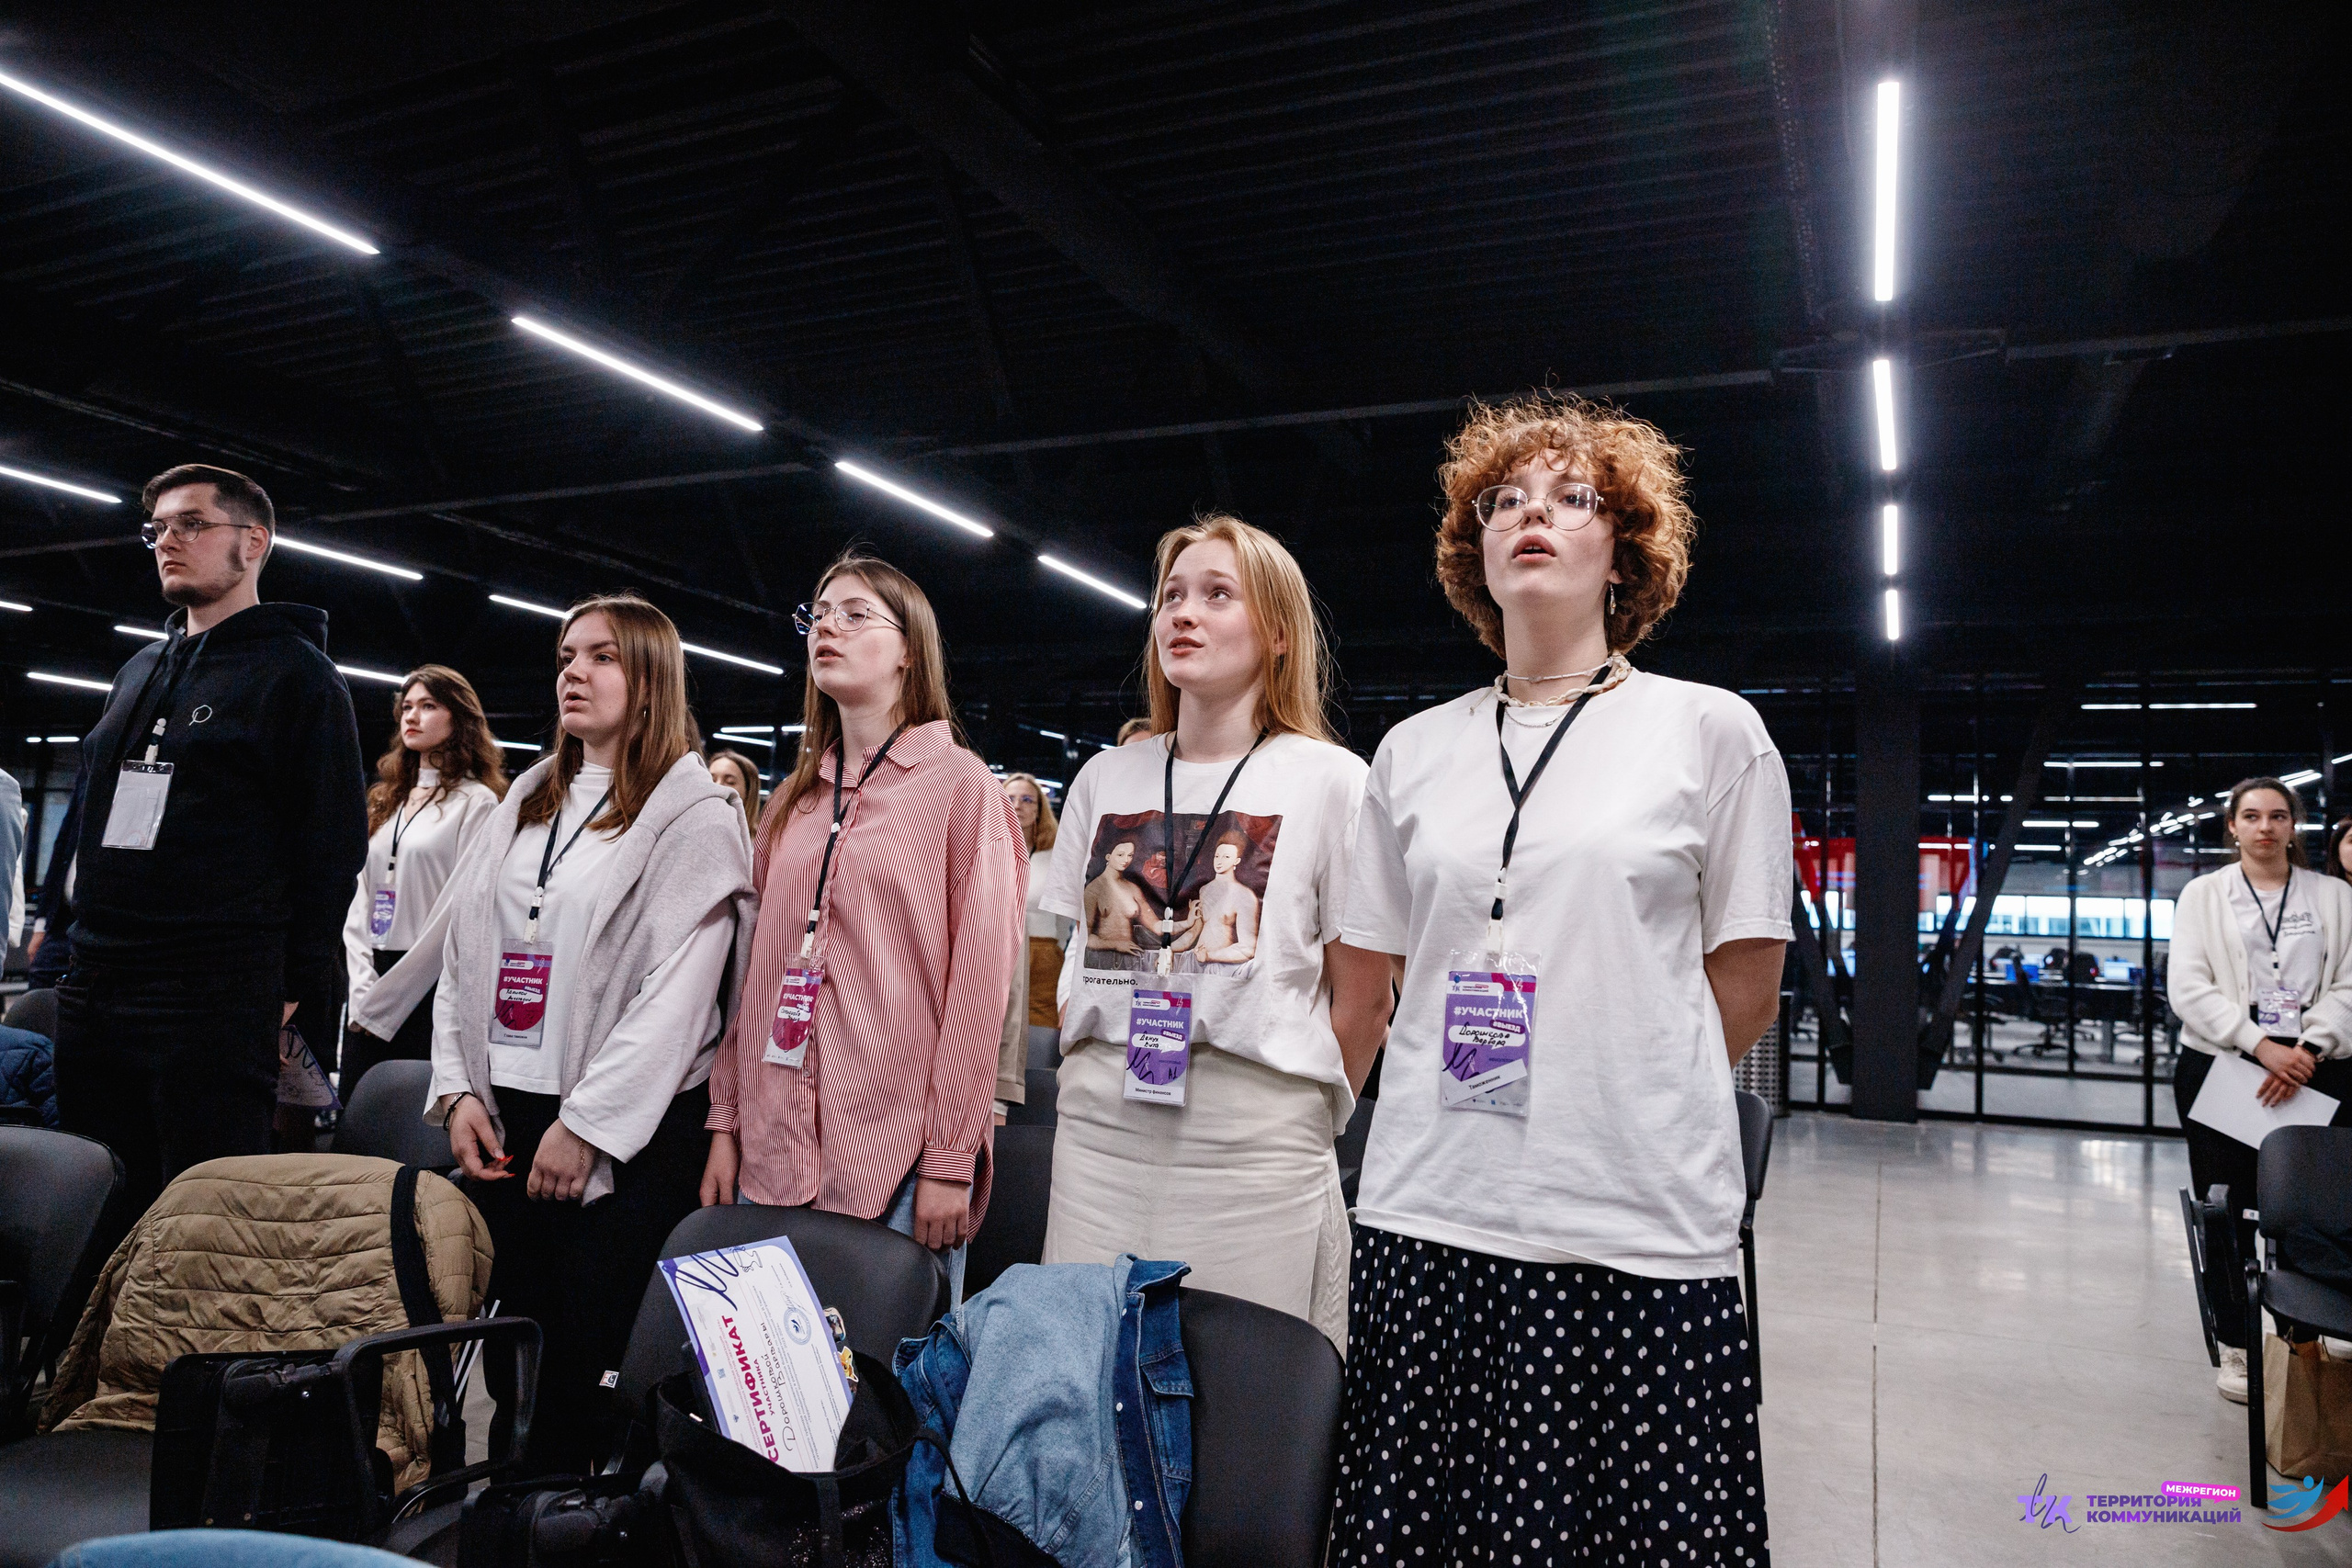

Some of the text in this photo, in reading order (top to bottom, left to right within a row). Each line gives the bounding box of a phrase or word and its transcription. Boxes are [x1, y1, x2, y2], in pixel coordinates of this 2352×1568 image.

[503, 976, 543, 985] #УЧАСТНИК
[1453, 1006, 1523, 1019] #УЧАСТНИК
[1136, 1018, 1184, 1029] #УЧАСТНИК
[1493, 1021, 1521, 1033] #ВЫЕЗД
[1468, 1074, 1501, 1090] Таможенник
[759, 1322, 786, 1386] Варвары
[721, 1314, 781, 1463] СЕРТИФИКАТ
[752, 1358, 775, 1415] УЧАСТНИКА
[760, 1353, 799, 1451] Дорошковой
